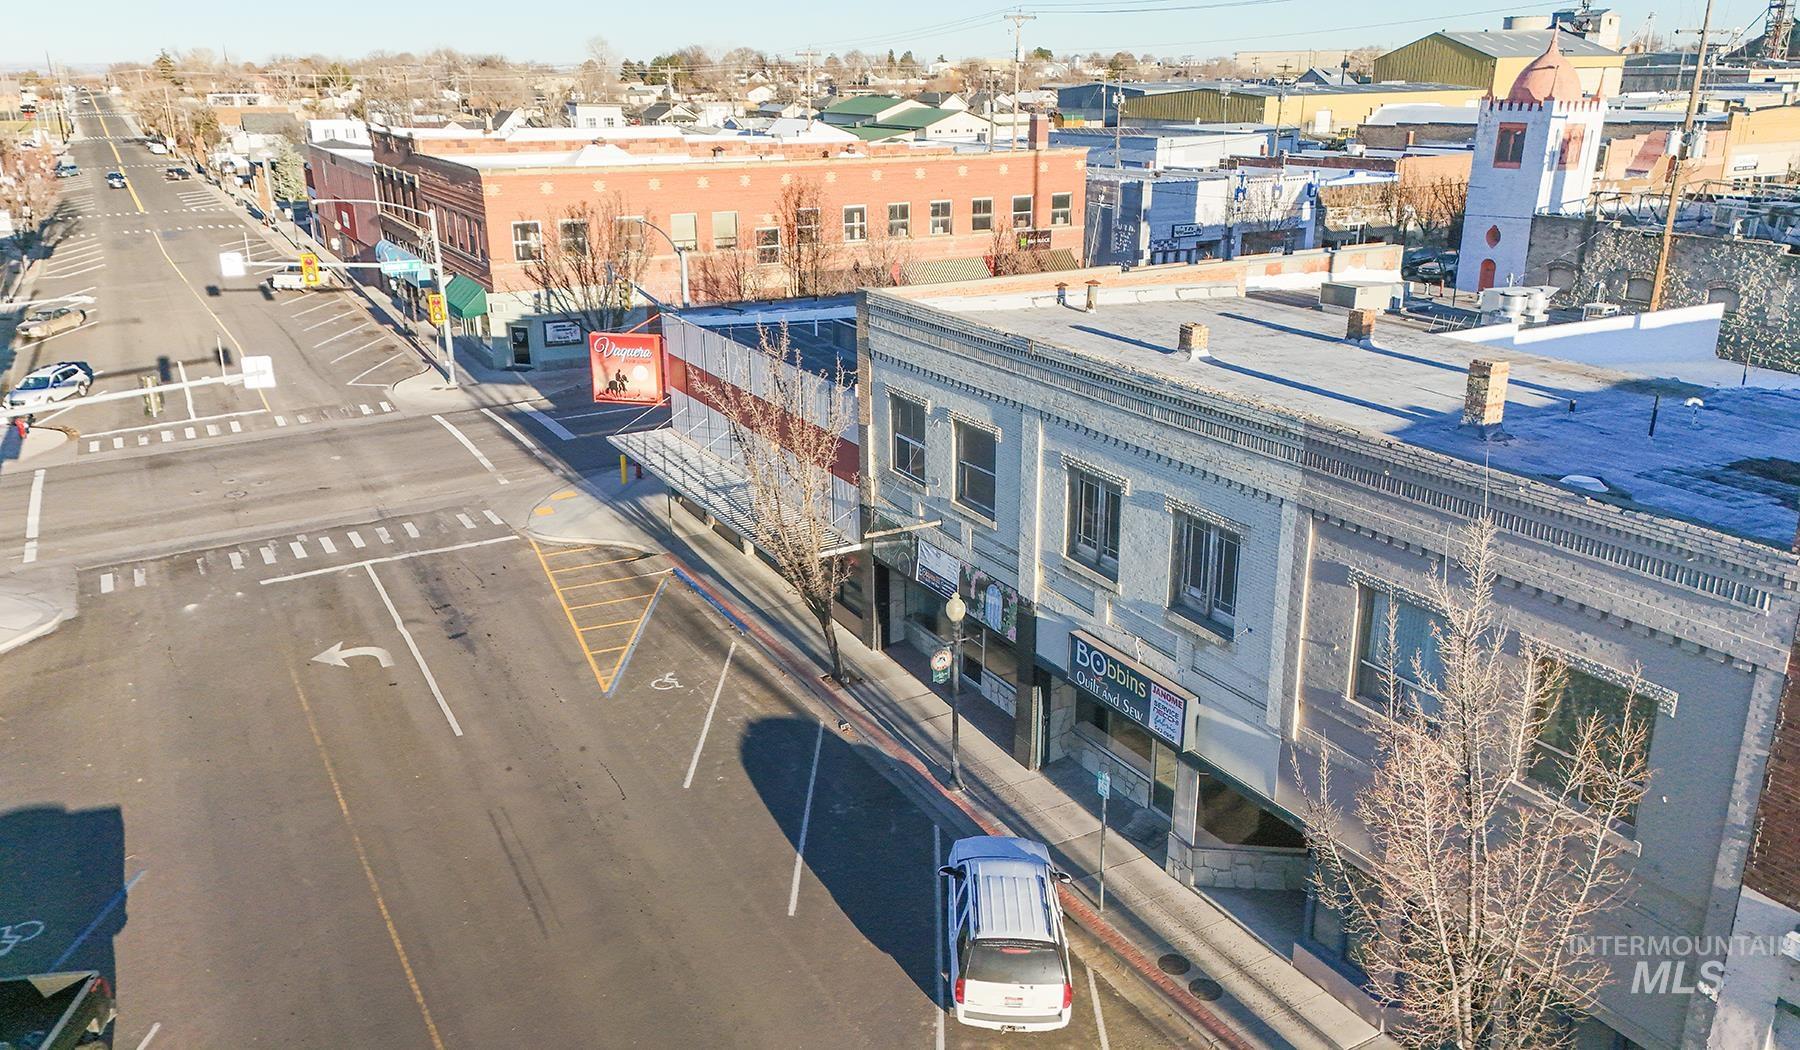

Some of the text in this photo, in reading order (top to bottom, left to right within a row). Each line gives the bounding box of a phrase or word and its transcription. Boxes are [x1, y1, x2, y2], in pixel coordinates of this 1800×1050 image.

[594, 336, 653, 363] Vaquera
[1152, 685, 1183, 710] JANOME
[1153, 699, 1180, 719] SERVICE
